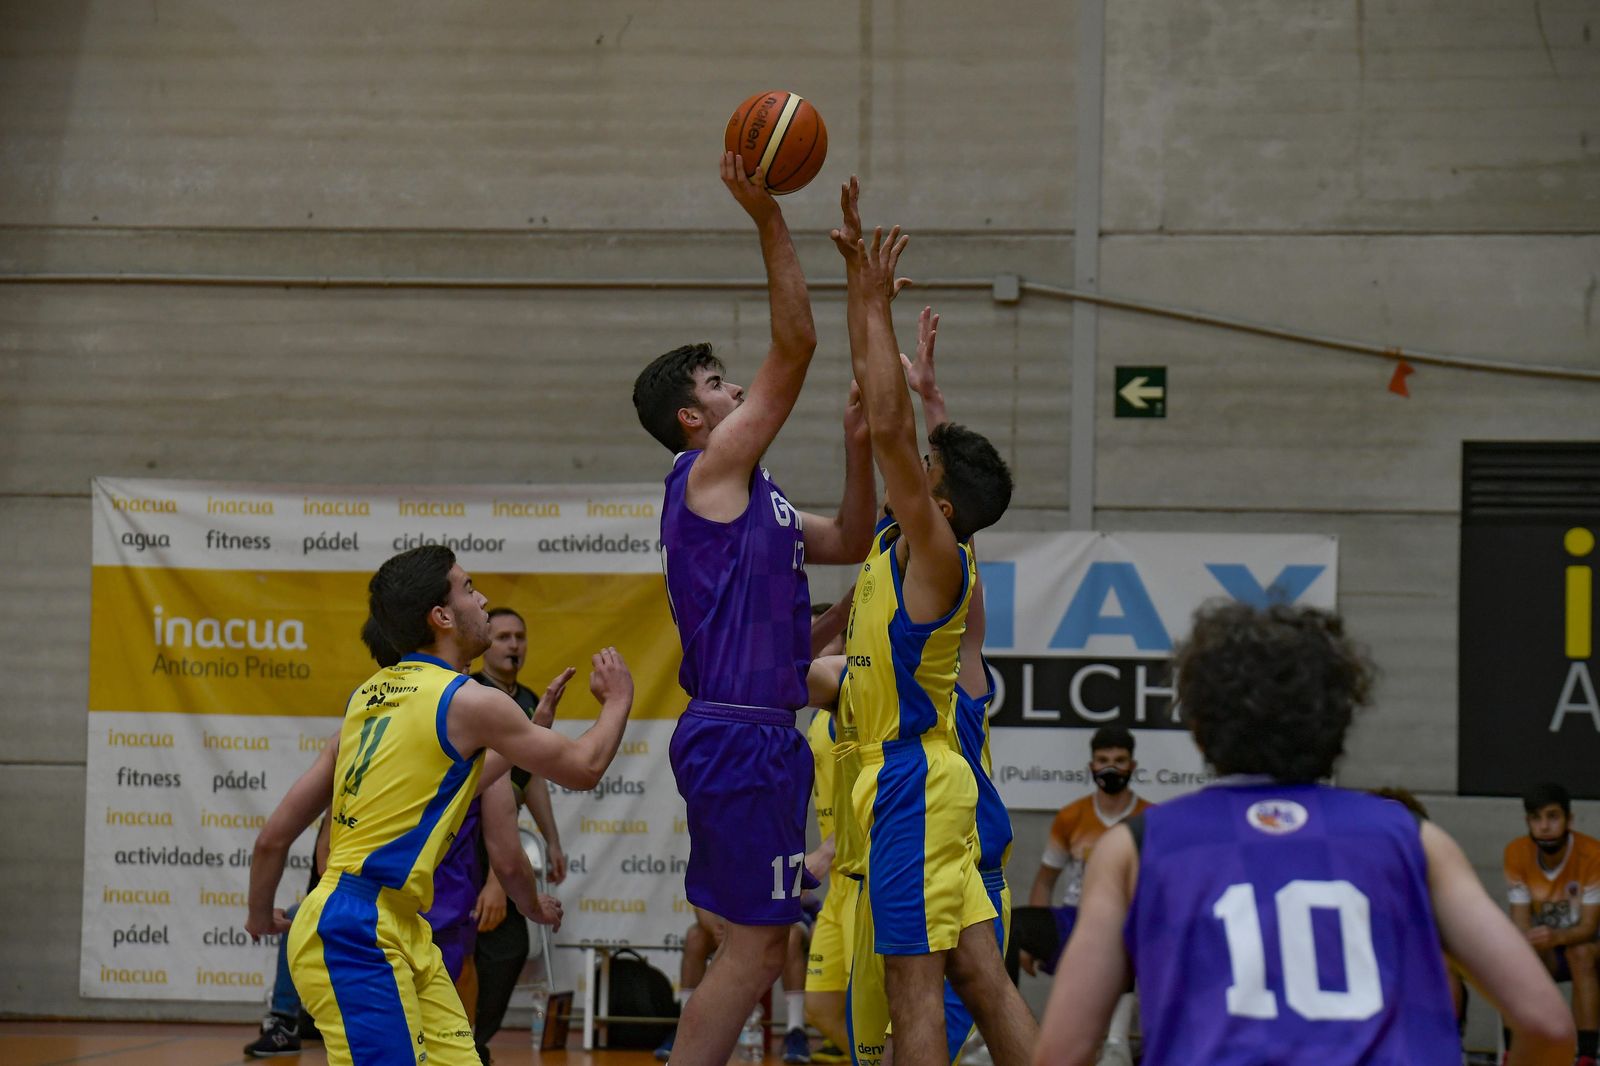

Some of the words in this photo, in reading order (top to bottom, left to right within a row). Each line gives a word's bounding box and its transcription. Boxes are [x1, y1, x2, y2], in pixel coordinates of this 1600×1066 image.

[745, 97, 777, 151] molten
[112, 494, 178, 515] inacua
[206, 495, 274, 516] inacua
[303, 496, 371, 517] inacua
[398, 497, 466, 518] inacua
[492, 498, 561, 519] inacua
[586, 498, 655, 519] inacua
[121, 531, 171, 552] agua
[205, 529, 272, 551] fitness
[303, 531, 360, 555] pádel
[442, 532, 506, 552] indoor
[537, 533, 650, 553] actividades
[153, 604, 308, 650] inacua
[152, 654, 239, 678] Antonio
[245, 655, 311, 680] Prieto
[107, 729, 174, 748] inacua
[203, 730, 270, 750] inacua
[116, 767, 181, 788] fitness
[213, 770, 267, 793] pádel
[1000, 765, 1091, 785] (Pulianas)
[106, 806, 173, 826] inacua
[580, 816, 648, 834] inacua
[115, 846, 224, 867] actividades
[621, 854, 666, 874] ciclo
[771, 852, 805, 900] 17
[103, 885, 170, 905] inacua
[200, 887, 250, 907] inacu
[579, 896, 647, 914] inacua
[113, 924, 169, 948] pádel
[203, 926, 247, 946] ciclo
[1212, 878, 1385, 1021] 10
[100, 965, 168, 985] inacua
[197, 966, 264, 987] inacua
